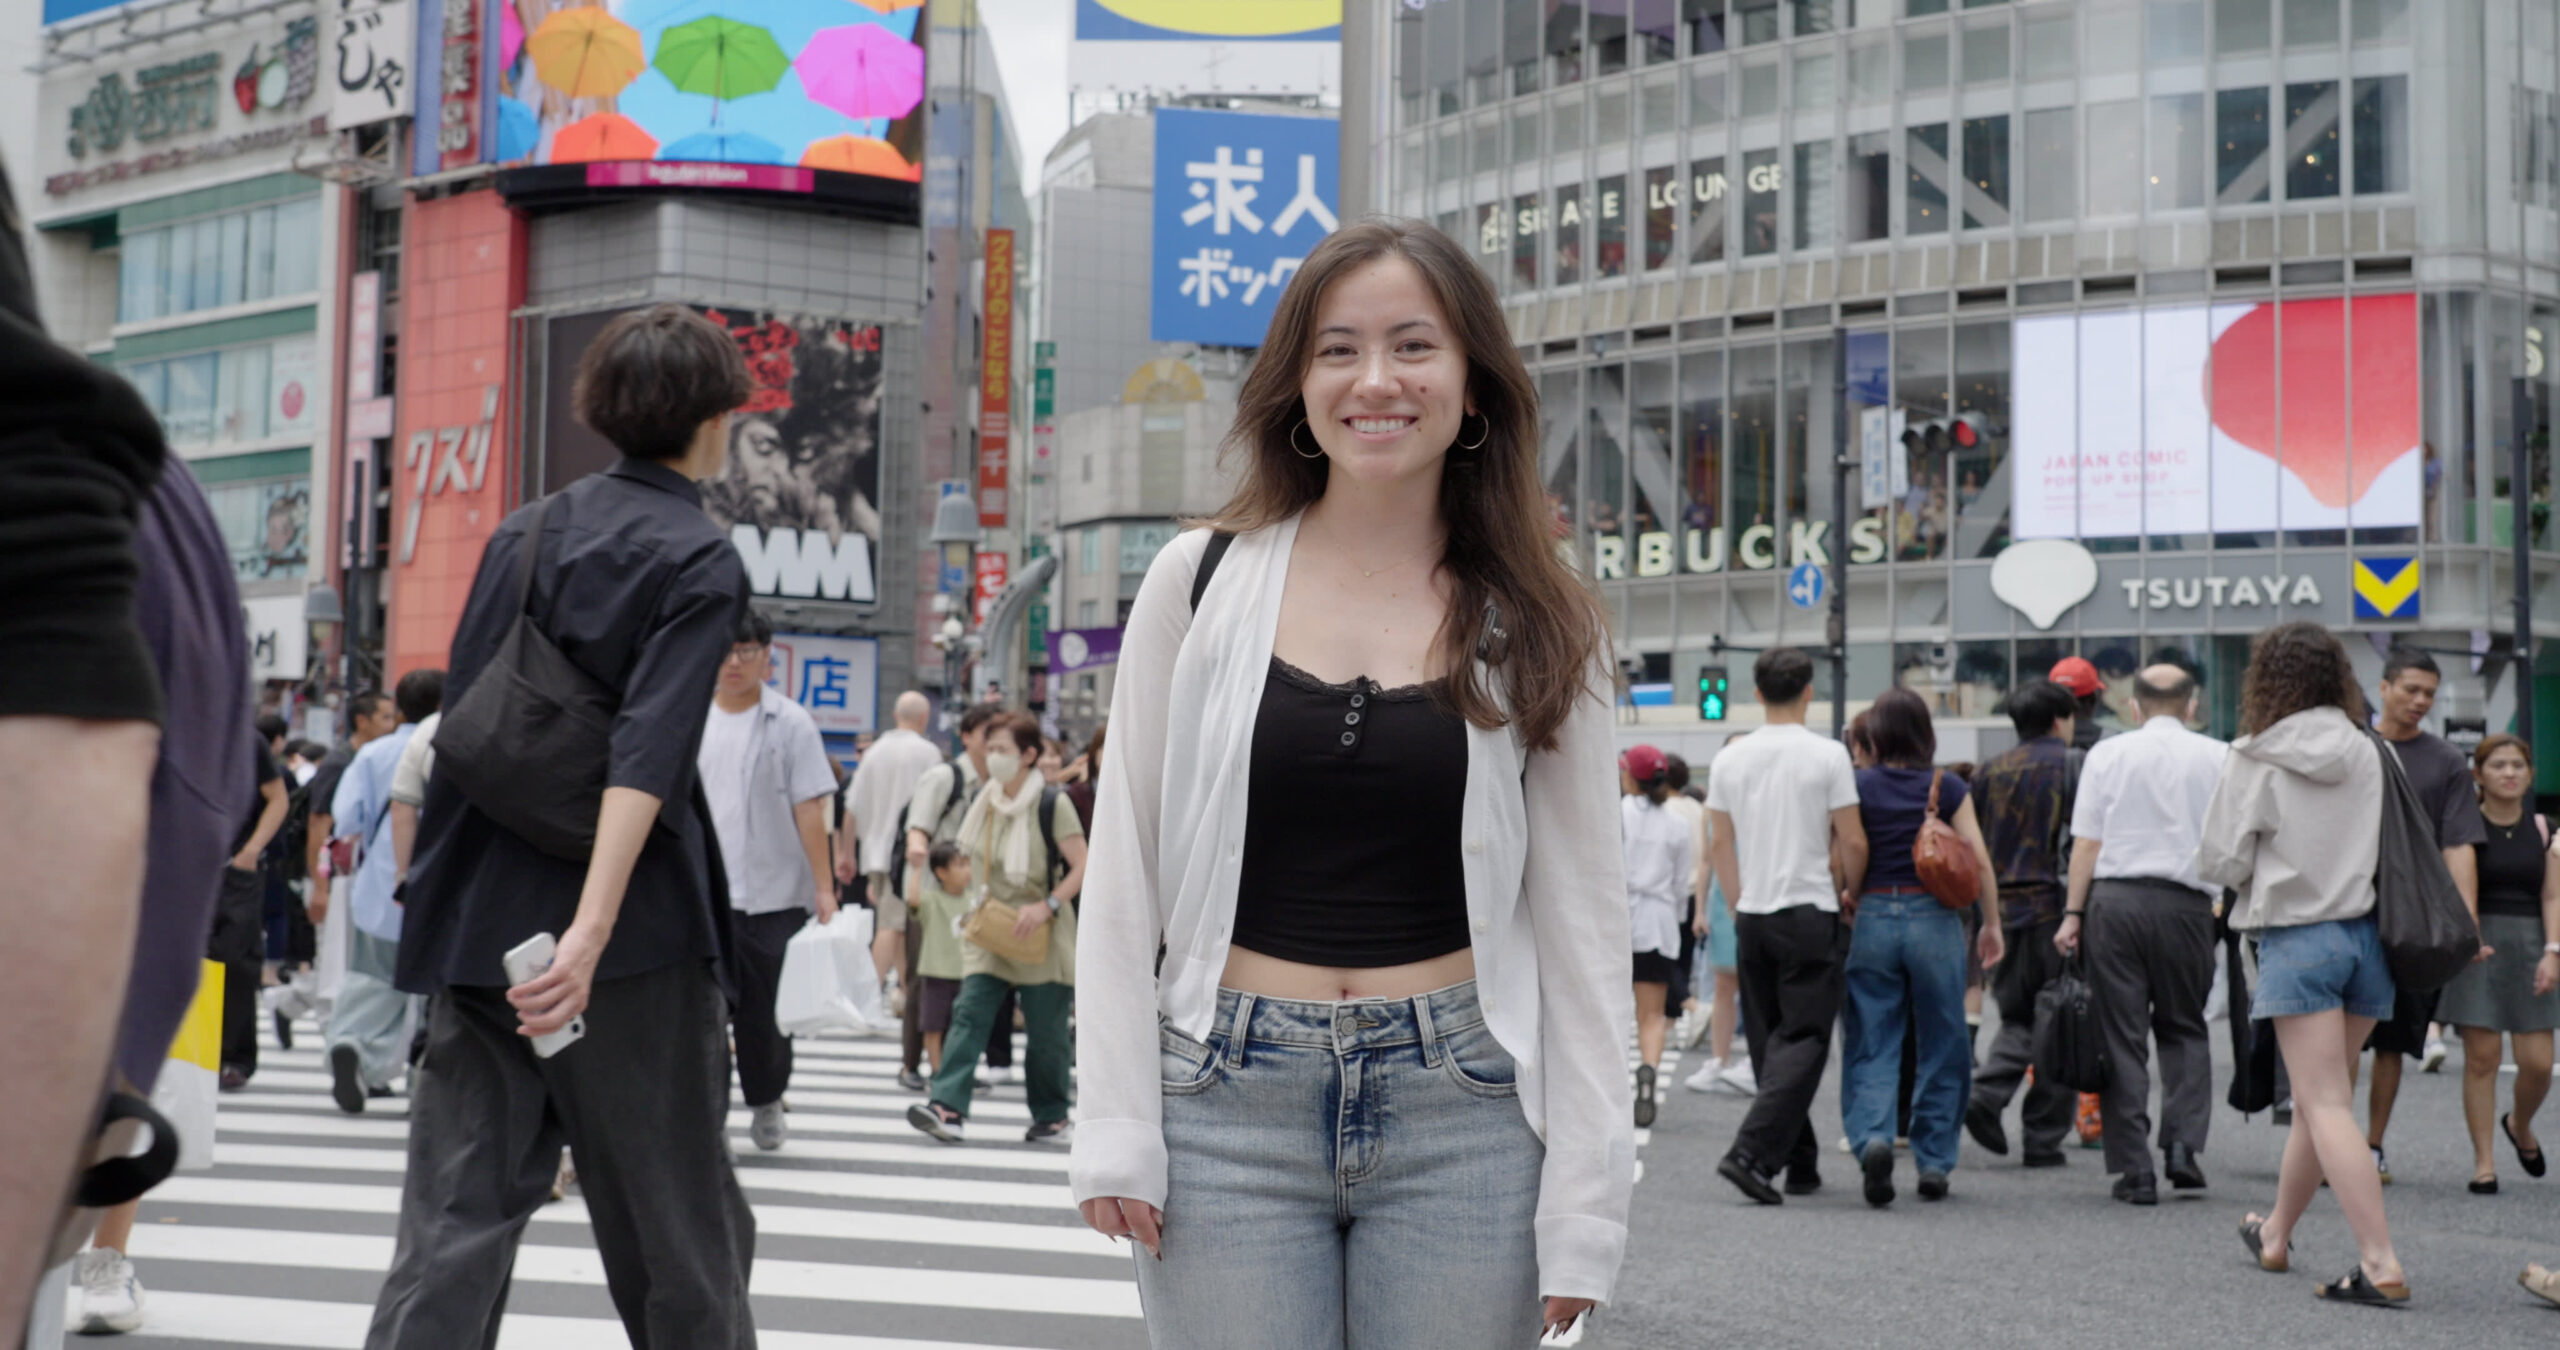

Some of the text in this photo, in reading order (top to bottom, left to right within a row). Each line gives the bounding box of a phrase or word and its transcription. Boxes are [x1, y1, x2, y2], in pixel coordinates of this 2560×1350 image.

[337, 0, 405, 109] じゃ
[1180, 146, 1339, 237] 求人
[400, 385, 501, 565] クスリ
[2041, 448, 2188, 471] JAPAN COMIC
[1593, 517, 1888, 582] RBUCKS
[2121, 574, 2322, 611] TSUTAYA
